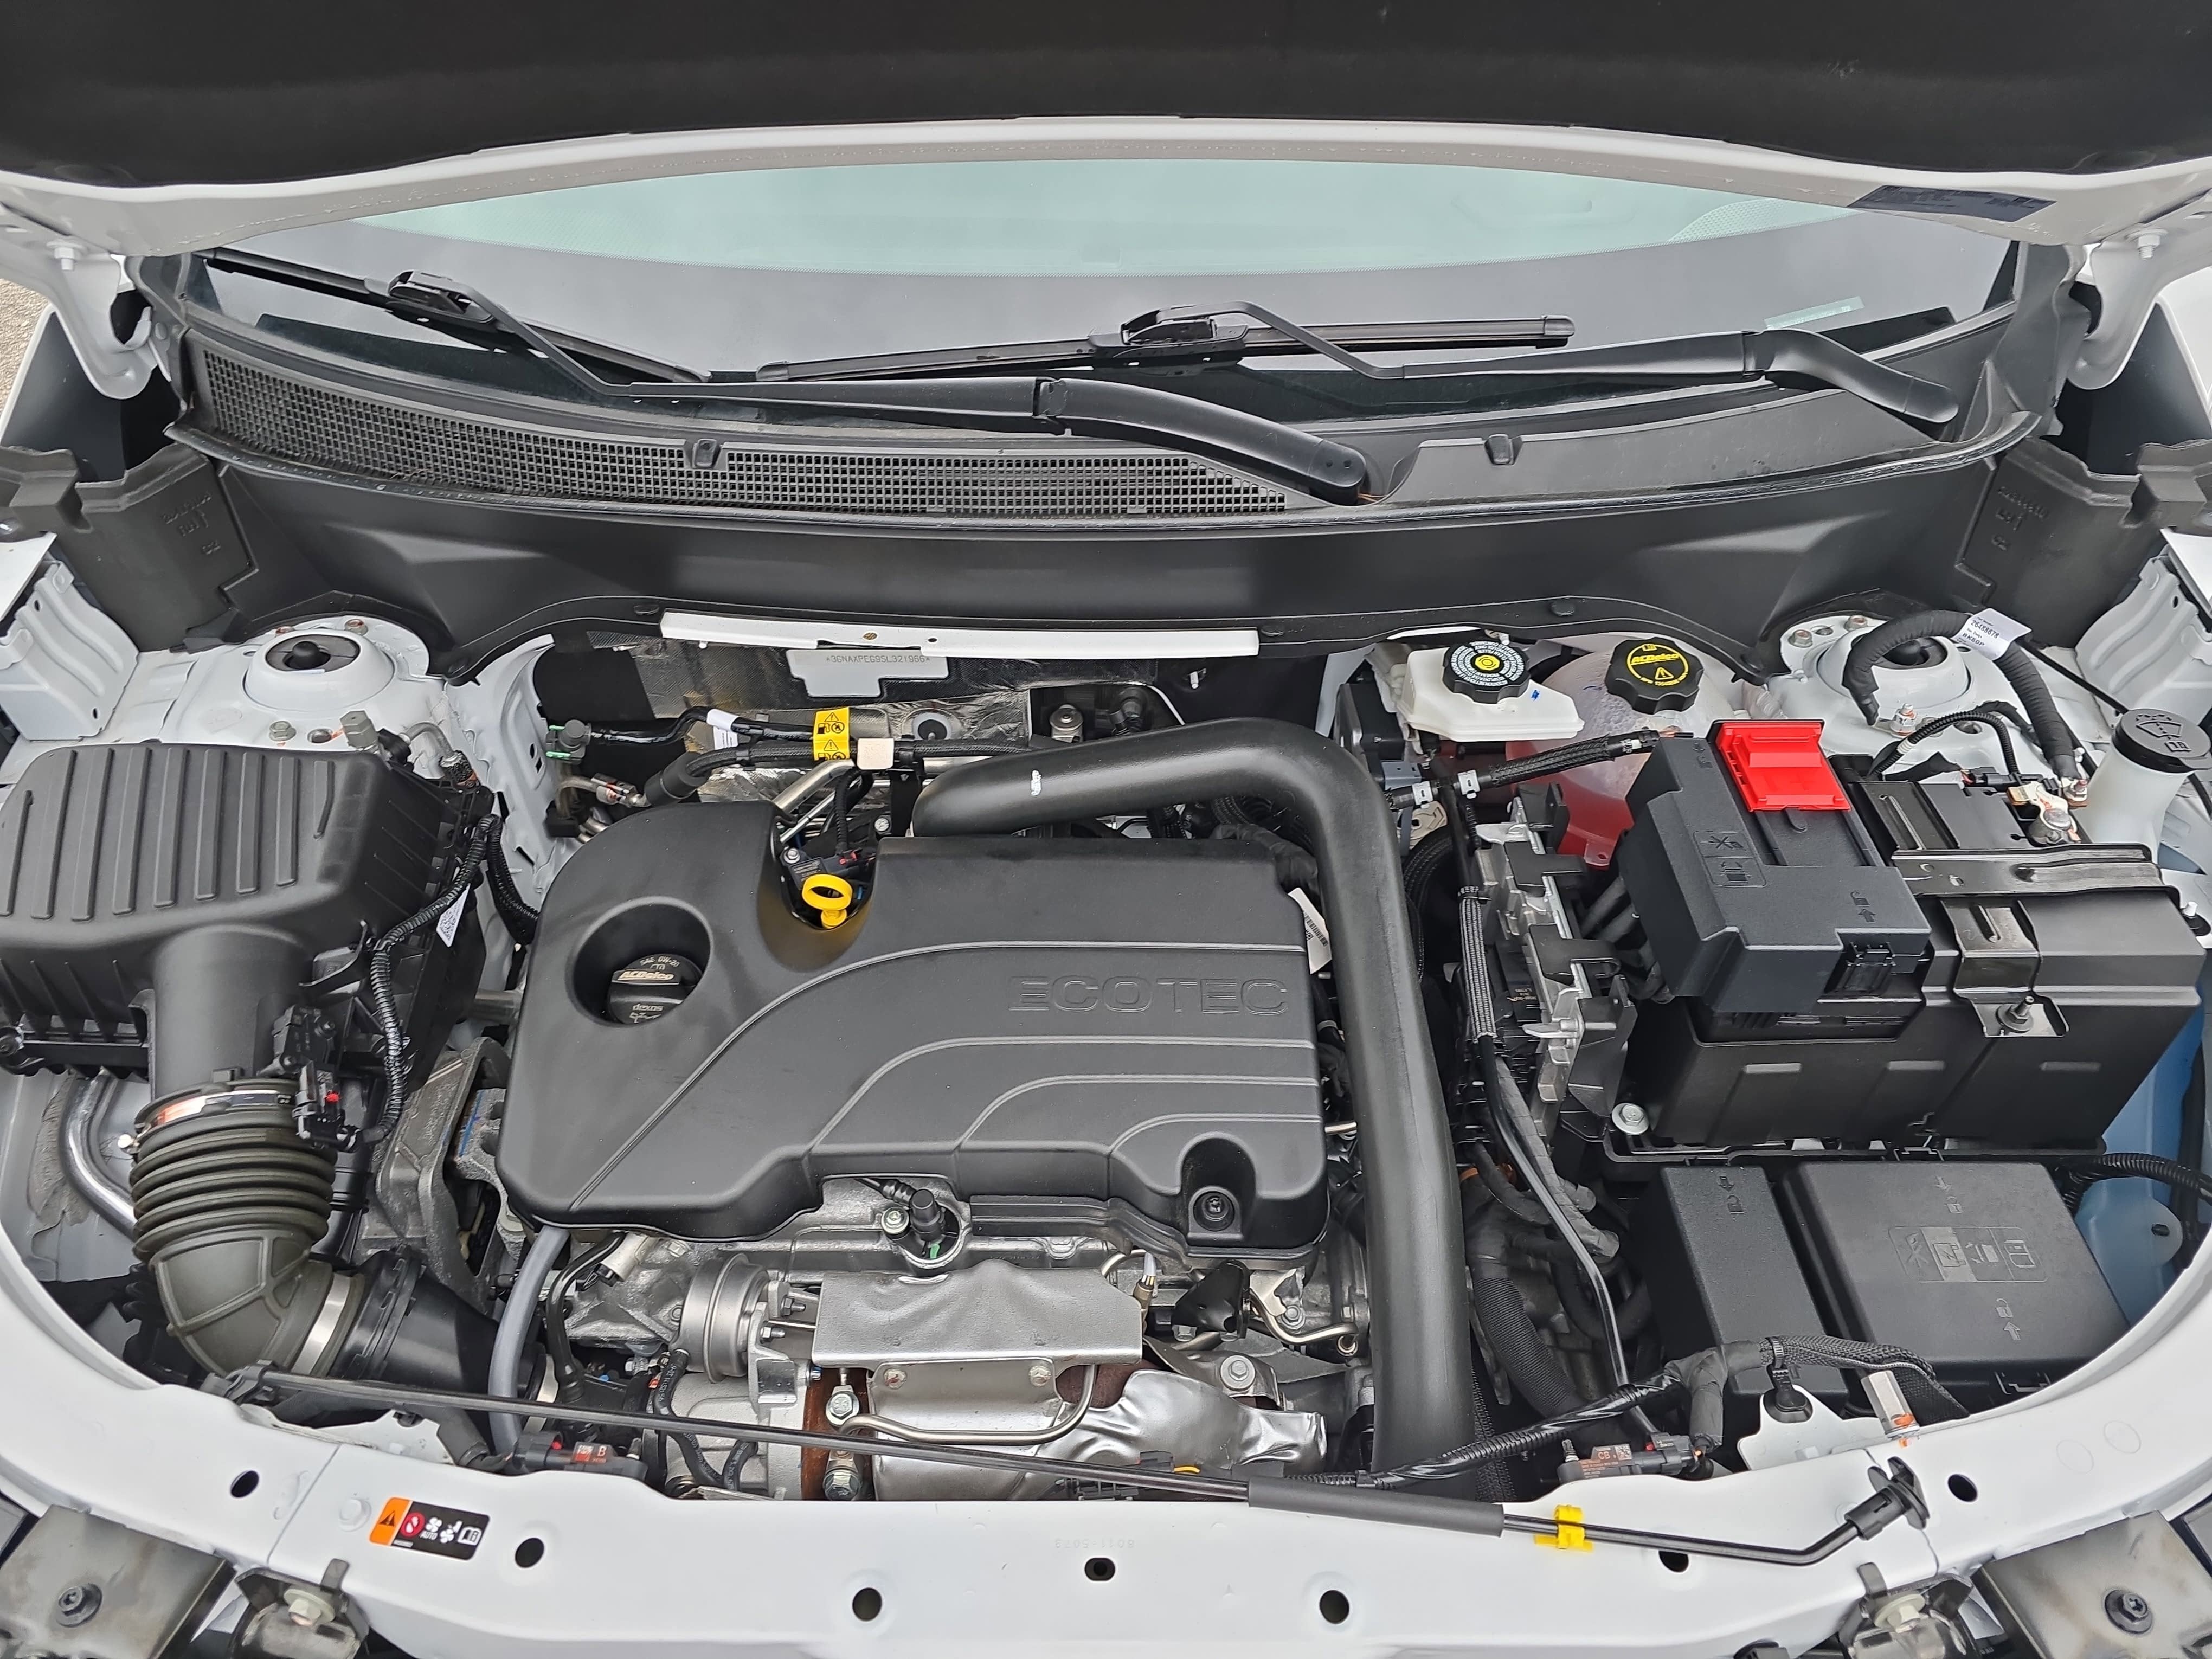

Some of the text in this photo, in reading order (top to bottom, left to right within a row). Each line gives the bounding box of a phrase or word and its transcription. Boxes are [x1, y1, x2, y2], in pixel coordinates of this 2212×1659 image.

[618, 971, 674, 981] ACDelco
[1008, 976, 1289, 1015] ECOTEC
[632, 1004, 664, 1012] dexos
[1597, 1451, 1611, 1459] CB
[420, 1531, 438, 1540] AUTO
